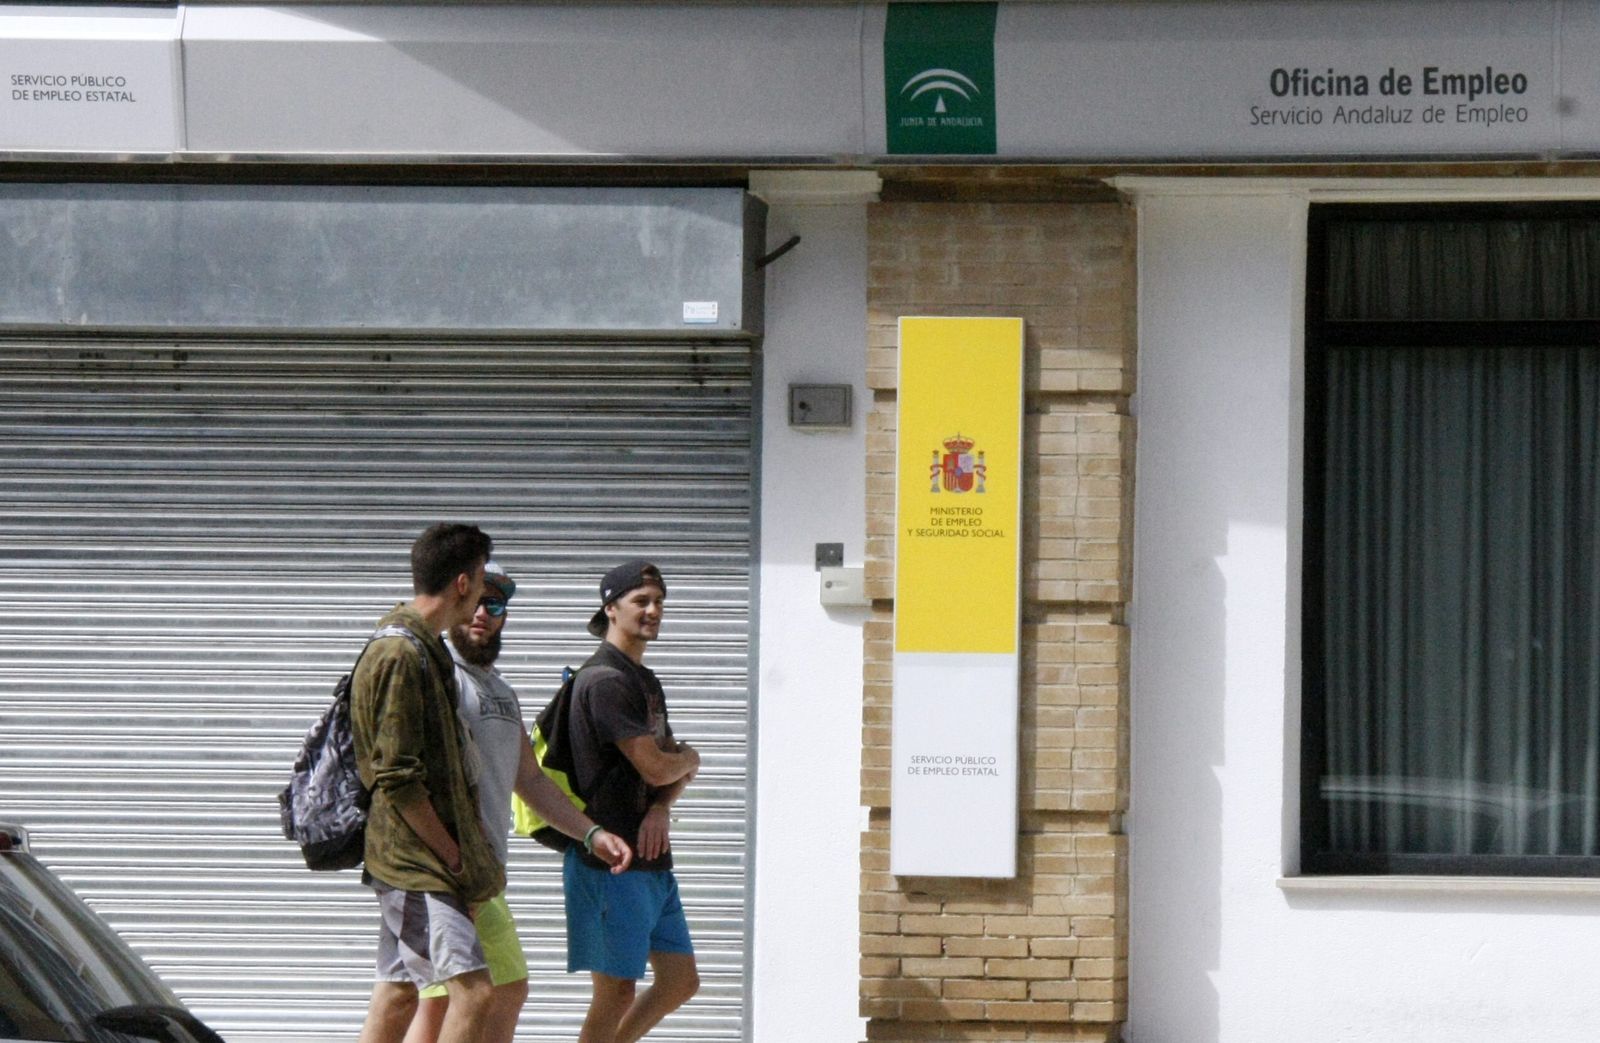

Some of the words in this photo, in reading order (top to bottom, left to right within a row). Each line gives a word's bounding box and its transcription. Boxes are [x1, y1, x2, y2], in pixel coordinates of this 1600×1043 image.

[10, 74, 68, 86] SERVICIO
[71, 73, 127, 87] PÚBLICO
[1269, 67, 1369, 97] Oficina
[1379, 67, 1412, 96] de
[1423, 66, 1528, 101] Empleo
[12, 89, 30, 101] DE
[32, 89, 82, 102] EMPLEO
[85, 90, 137, 103] ESTATAL
[1250, 105, 1323, 126] Servicio
[1333, 104, 1413, 125] Andaluz
[1422, 104, 1446, 124] de
[1456, 103, 1529, 127] Empleo
[929, 507, 984, 516] MINISTERIO
[930, 517, 944, 527] DE
[946, 517, 983, 527] EMPLEO
[907, 528, 914, 537] Y
[915, 528, 969, 538] SEGURIDAD
[971, 529, 1006, 538] SOCIAL
[911, 755, 953, 764] SERVICIO
[955, 754, 997, 765] PÚBLICO
[907, 766, 921, 775] DE
[922, 766, 960, 776] EMPLEO
[961, 767, 1000, 777] ESTATAL
